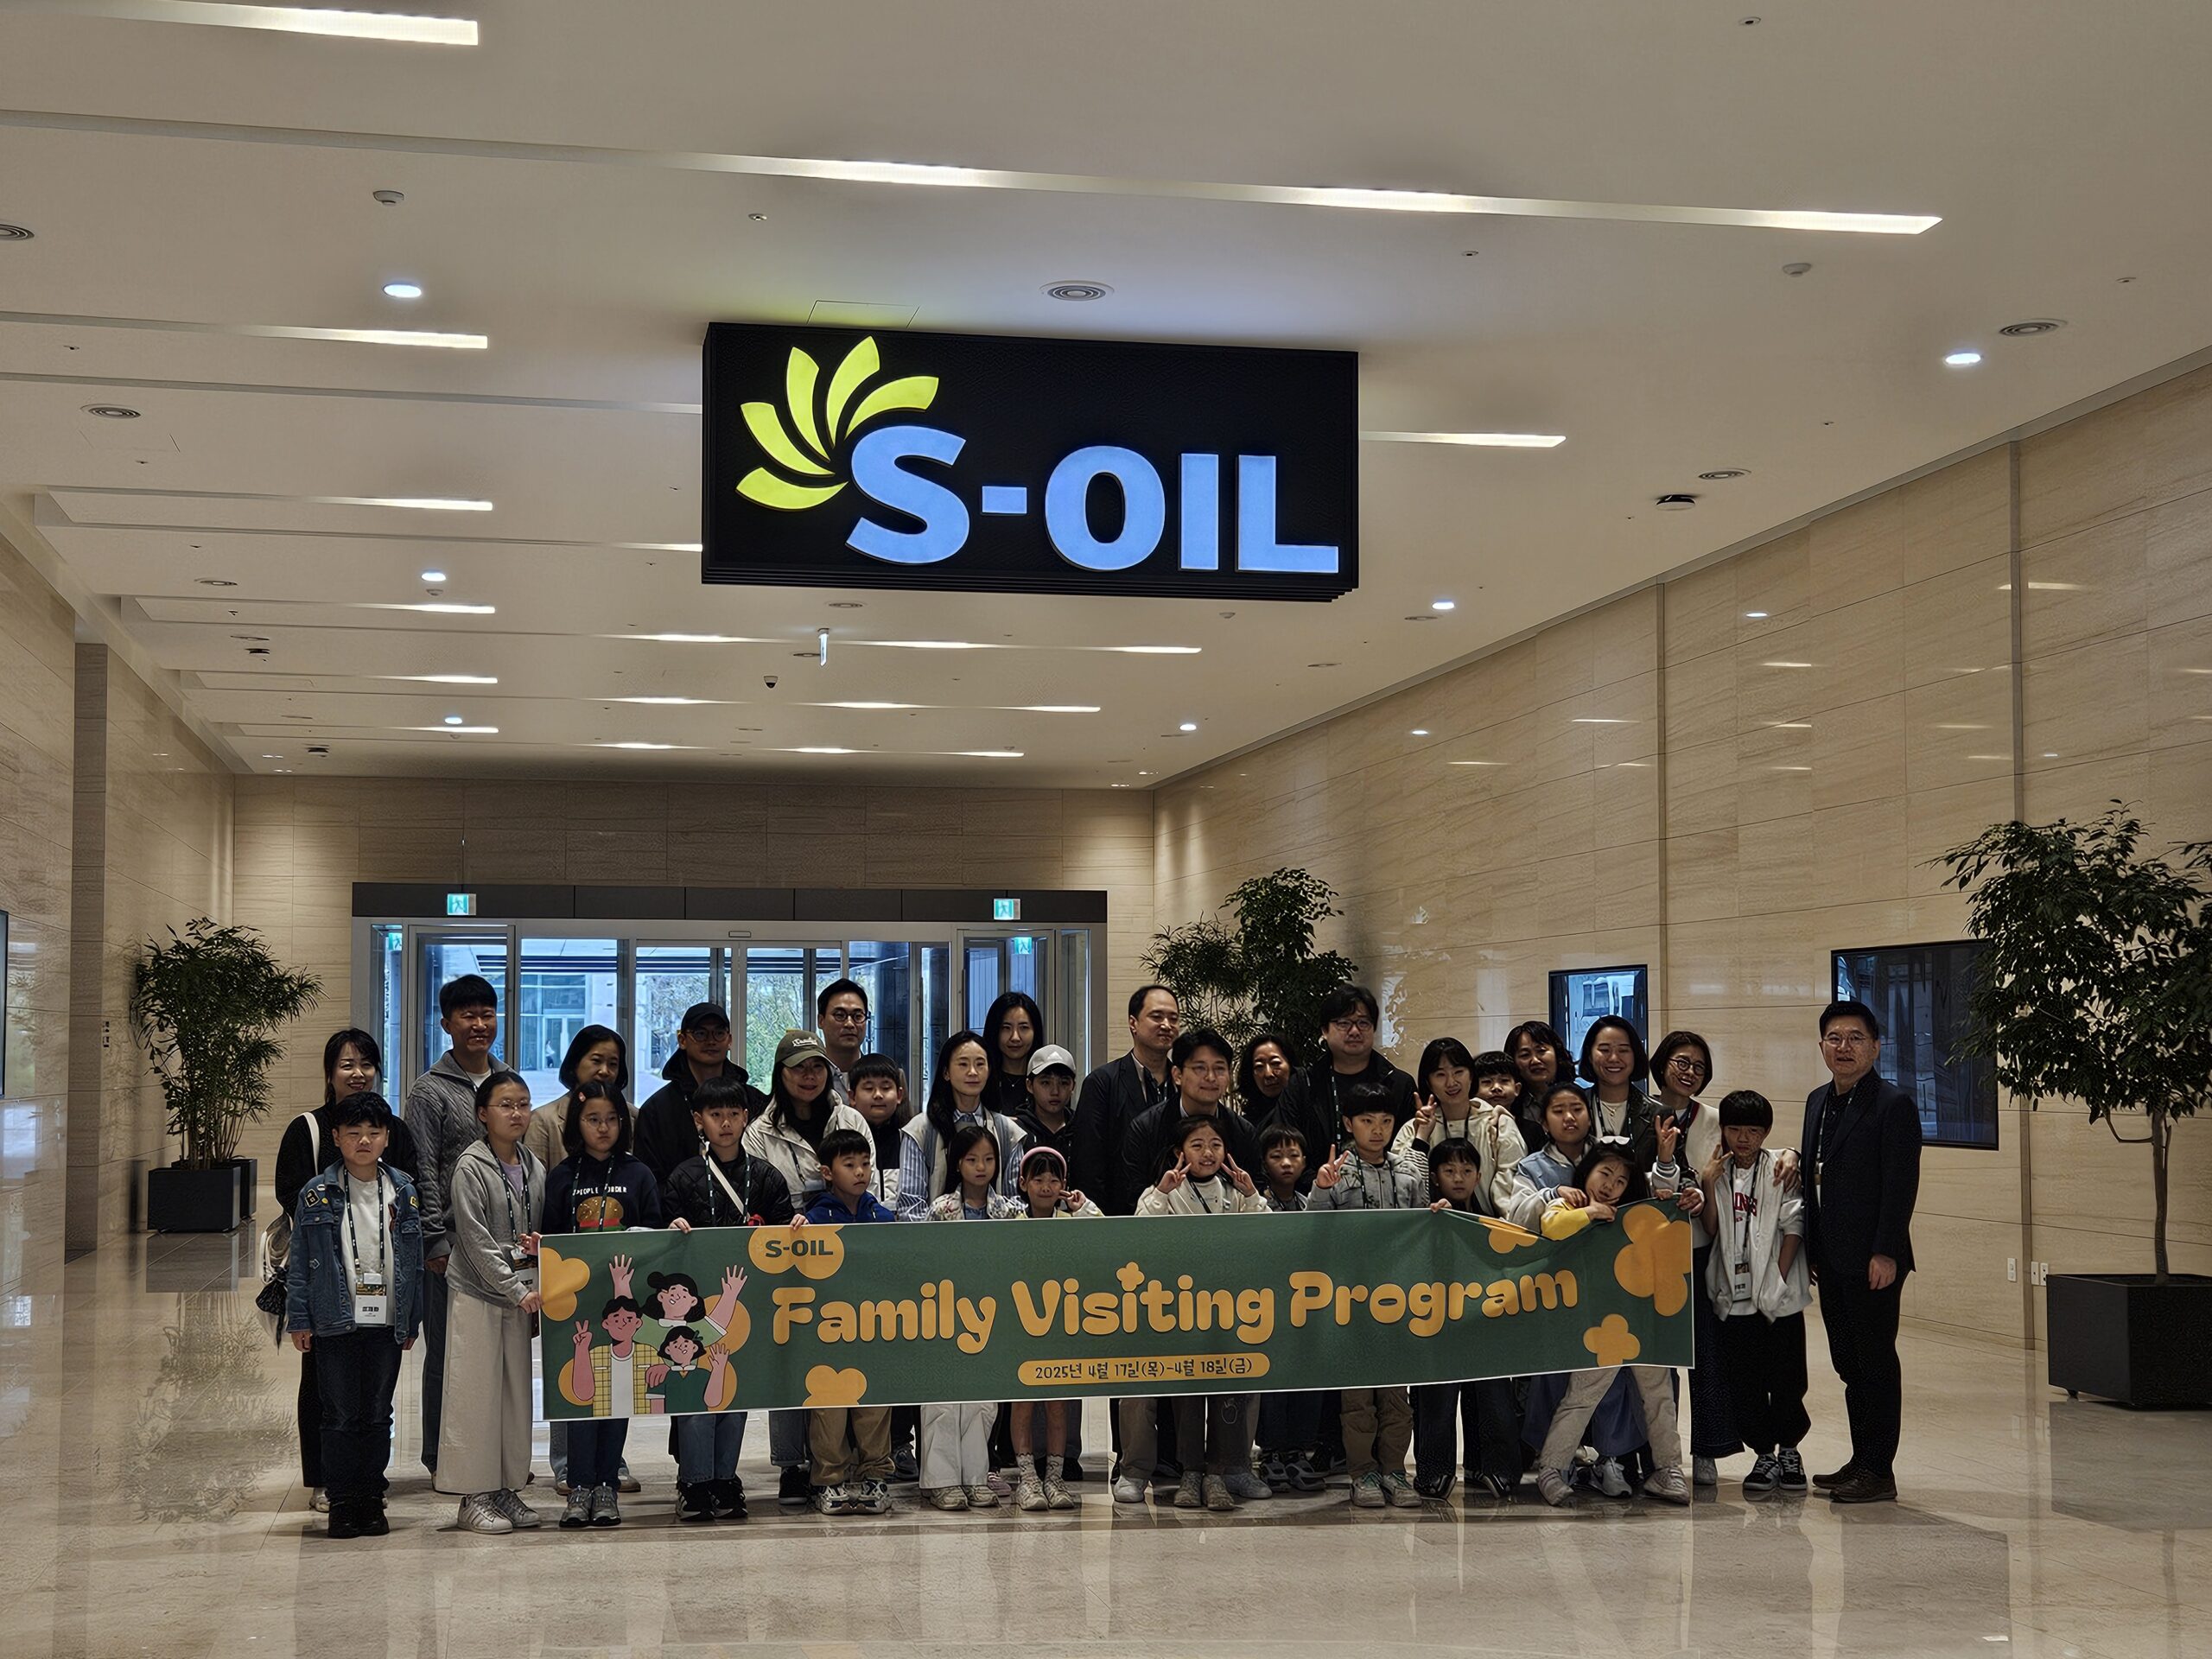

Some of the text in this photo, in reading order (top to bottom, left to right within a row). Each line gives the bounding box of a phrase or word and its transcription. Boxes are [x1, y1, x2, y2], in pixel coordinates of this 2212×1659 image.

[846, 425, 1339, 573] S-OIL
[765, 1239, 834, 1258] S-OIL
[772, 1262, 1579, 1354] Family Visiting Program
[1035, 1363, 1082, 1379] 2025년
[1088, 1361, 1109, 1380] 4월
[1199, 1357, 1253, 1375] 18일(금)
